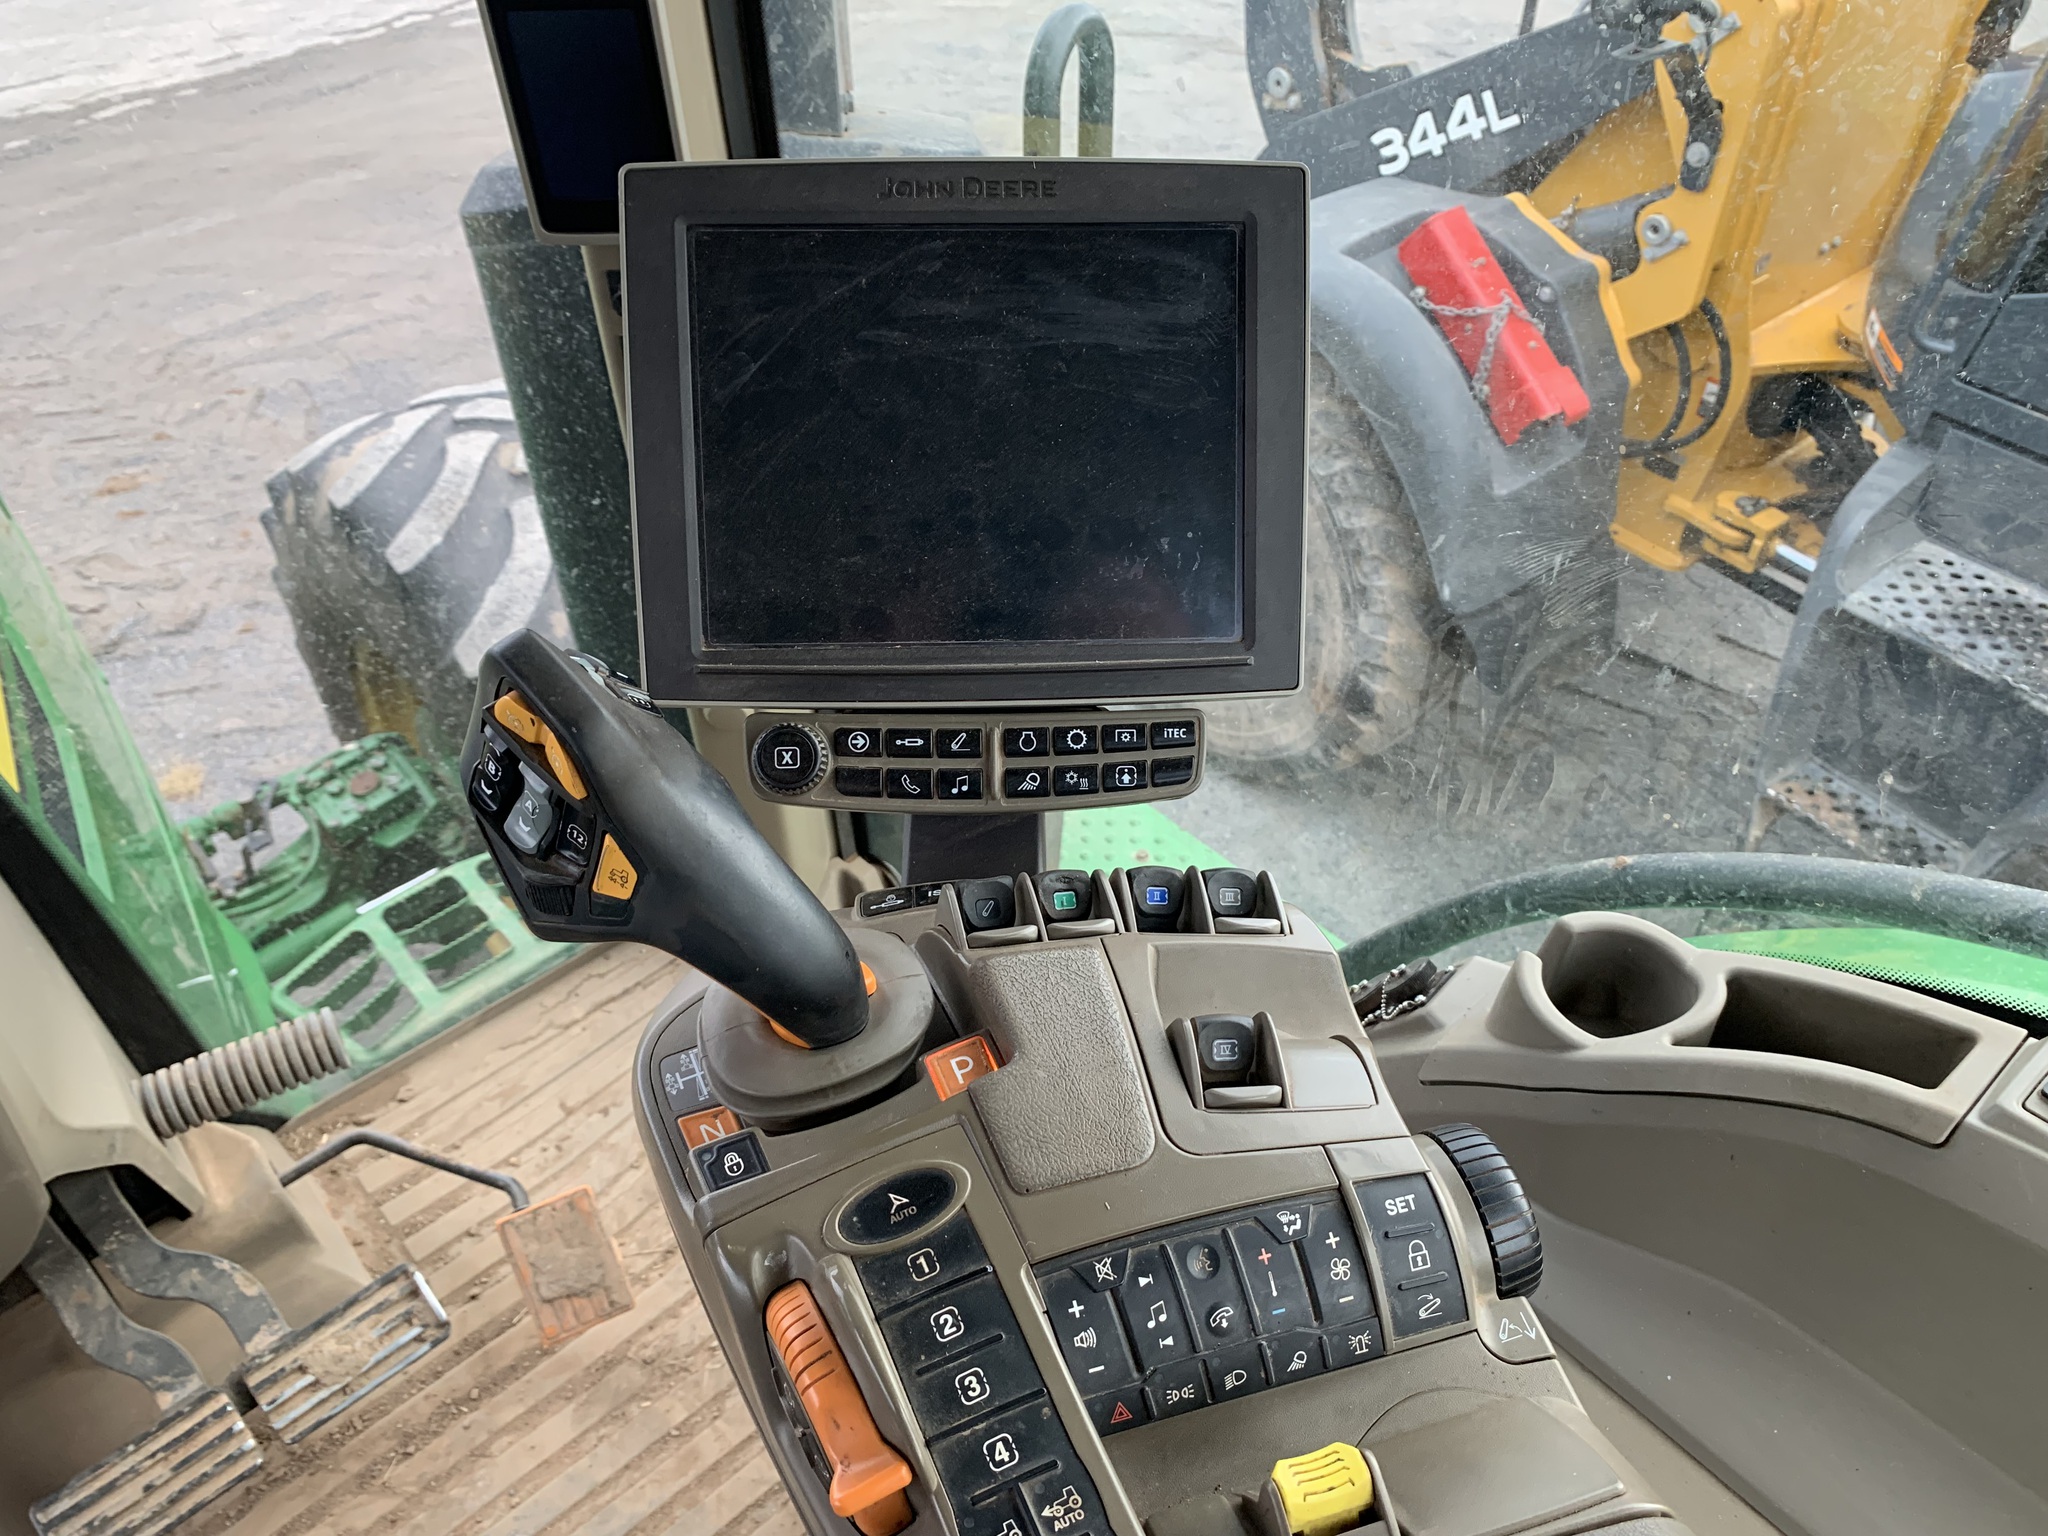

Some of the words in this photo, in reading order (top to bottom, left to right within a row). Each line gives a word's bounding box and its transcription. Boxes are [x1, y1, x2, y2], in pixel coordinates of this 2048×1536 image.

[1370, 89, 1521, 176] 344L
[876, 177, 953, 199] JOHN
[961, 176, 1058, 199] DEERE
[1163, 727, 1187, 739] iTEC
[487, 759, 497, 774] B
[524, 800, 534, 813] A
[571, 828, 585, 845] 12
[949, 1055, 974, 1084] P
[699, 1119, 727, 1144] N
[889, 1205, 918, 1224] AUTO
[1384, 1193, 1416, 1216] SET
[916, 1253, 931, 1275] 1
[938, 1312, 959, 1336] 2
[964, 1374, 982, 1398] 3
[993, 1440, 1011, 1463] 4
[1053, 1509, 1085, 1532] AUTO
